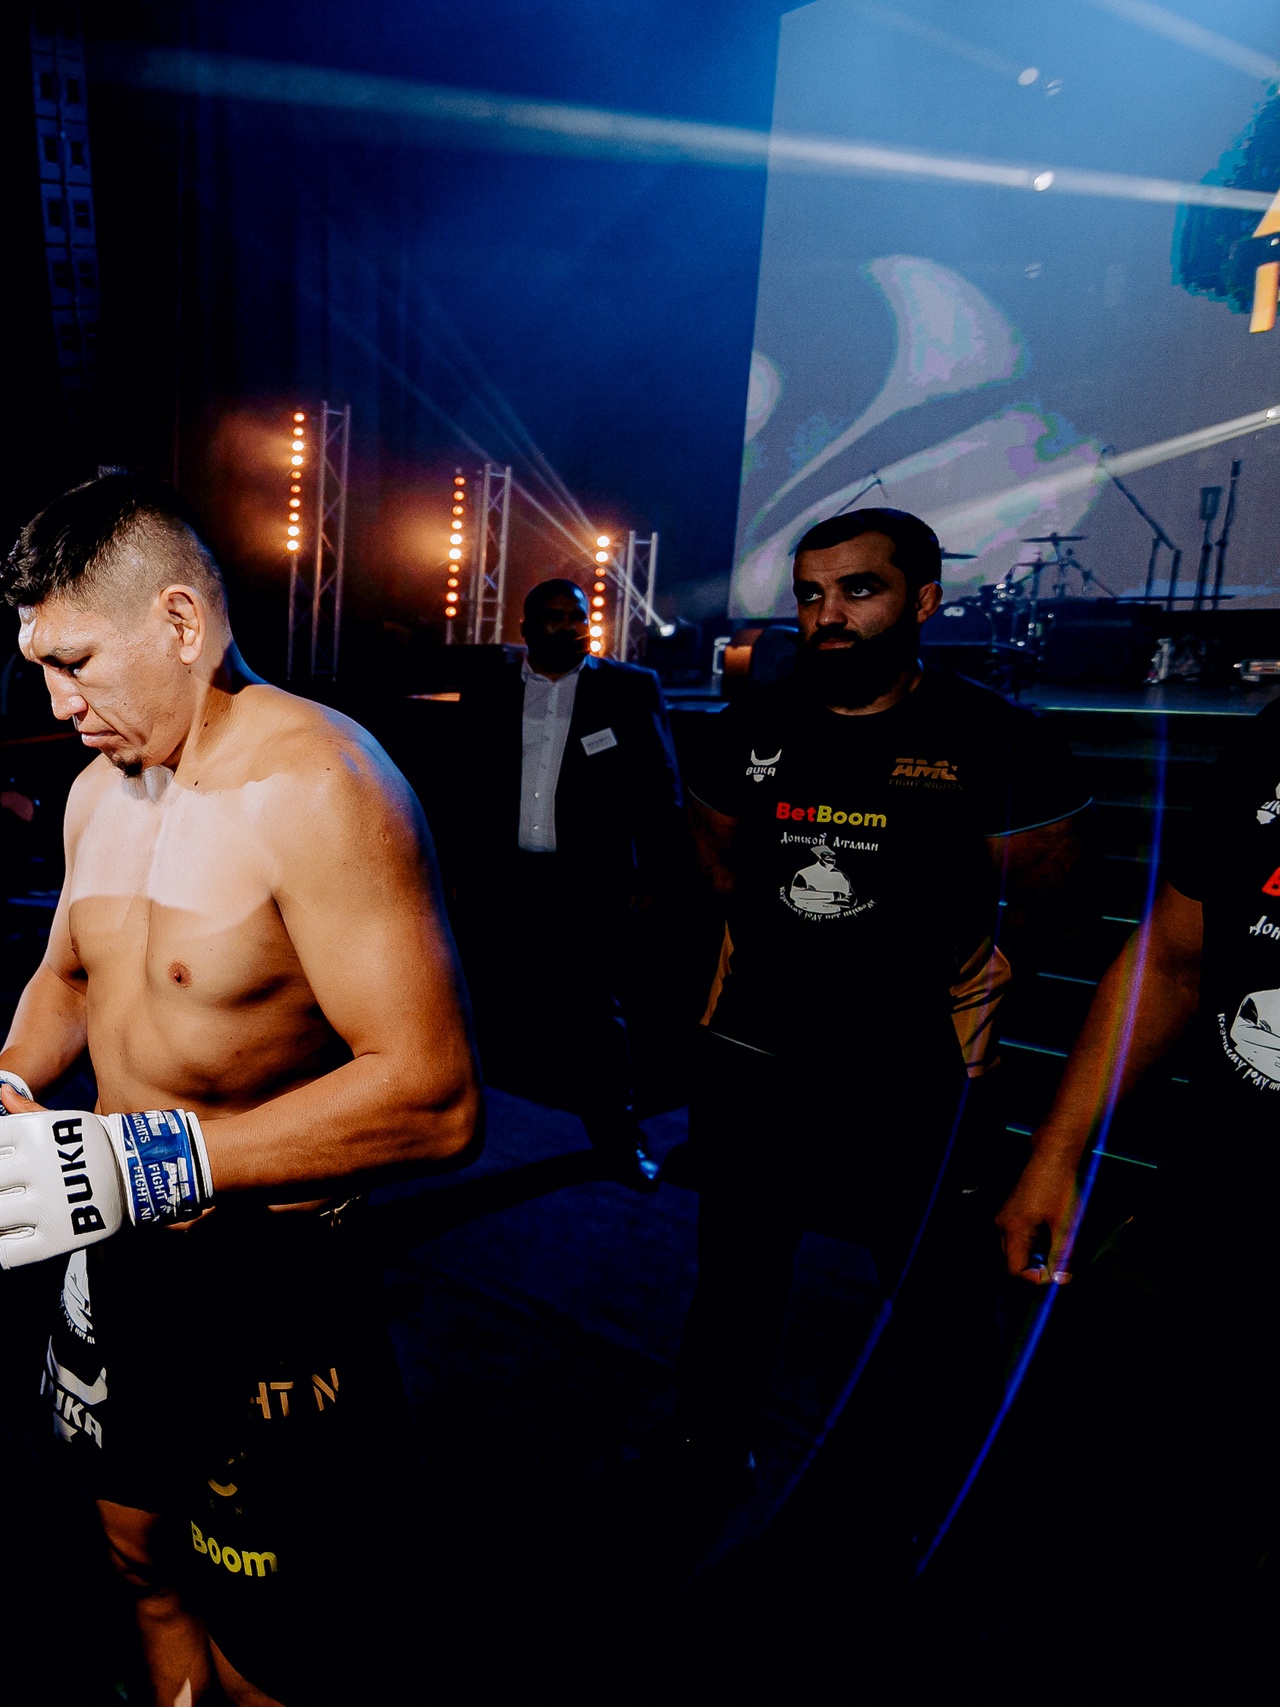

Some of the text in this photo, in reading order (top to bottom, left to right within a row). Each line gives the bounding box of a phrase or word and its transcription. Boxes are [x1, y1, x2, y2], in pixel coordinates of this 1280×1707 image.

[745, 766, 777, 777] BUKA
[889, 778, 920, 788] FIGHT
[775, 801, 887, 828] BetBoom
[780, 831, 879, 852] Донской Атаман
[51, 1117, 107, 1236] BUKA
[133, 1165, 149, 1203] FIGHT
[148, 1163, 168, 1201] FIGHT
[190, 1520, 278, 1578] Boom
